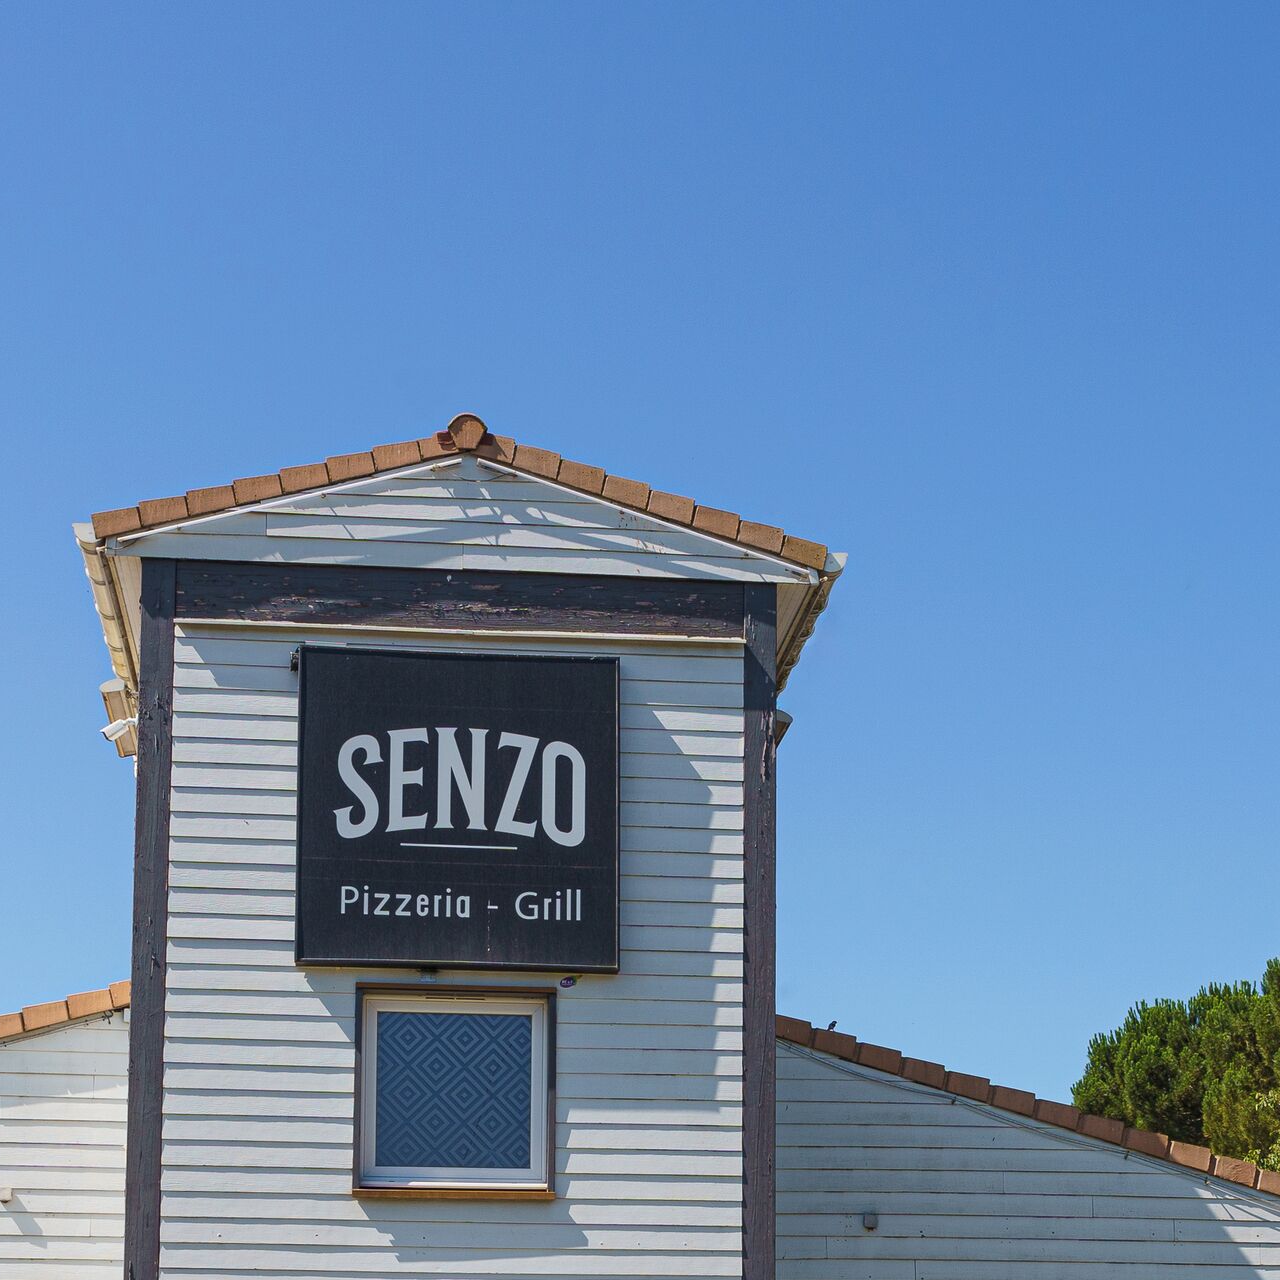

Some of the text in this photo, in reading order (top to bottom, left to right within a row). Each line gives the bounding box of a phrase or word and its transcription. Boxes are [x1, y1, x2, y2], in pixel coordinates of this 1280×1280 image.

[333, 727, 586, 847] SENZO
[340, 885, 470, 918] Pizzeria
[515, 889, 582, 921] Grill
